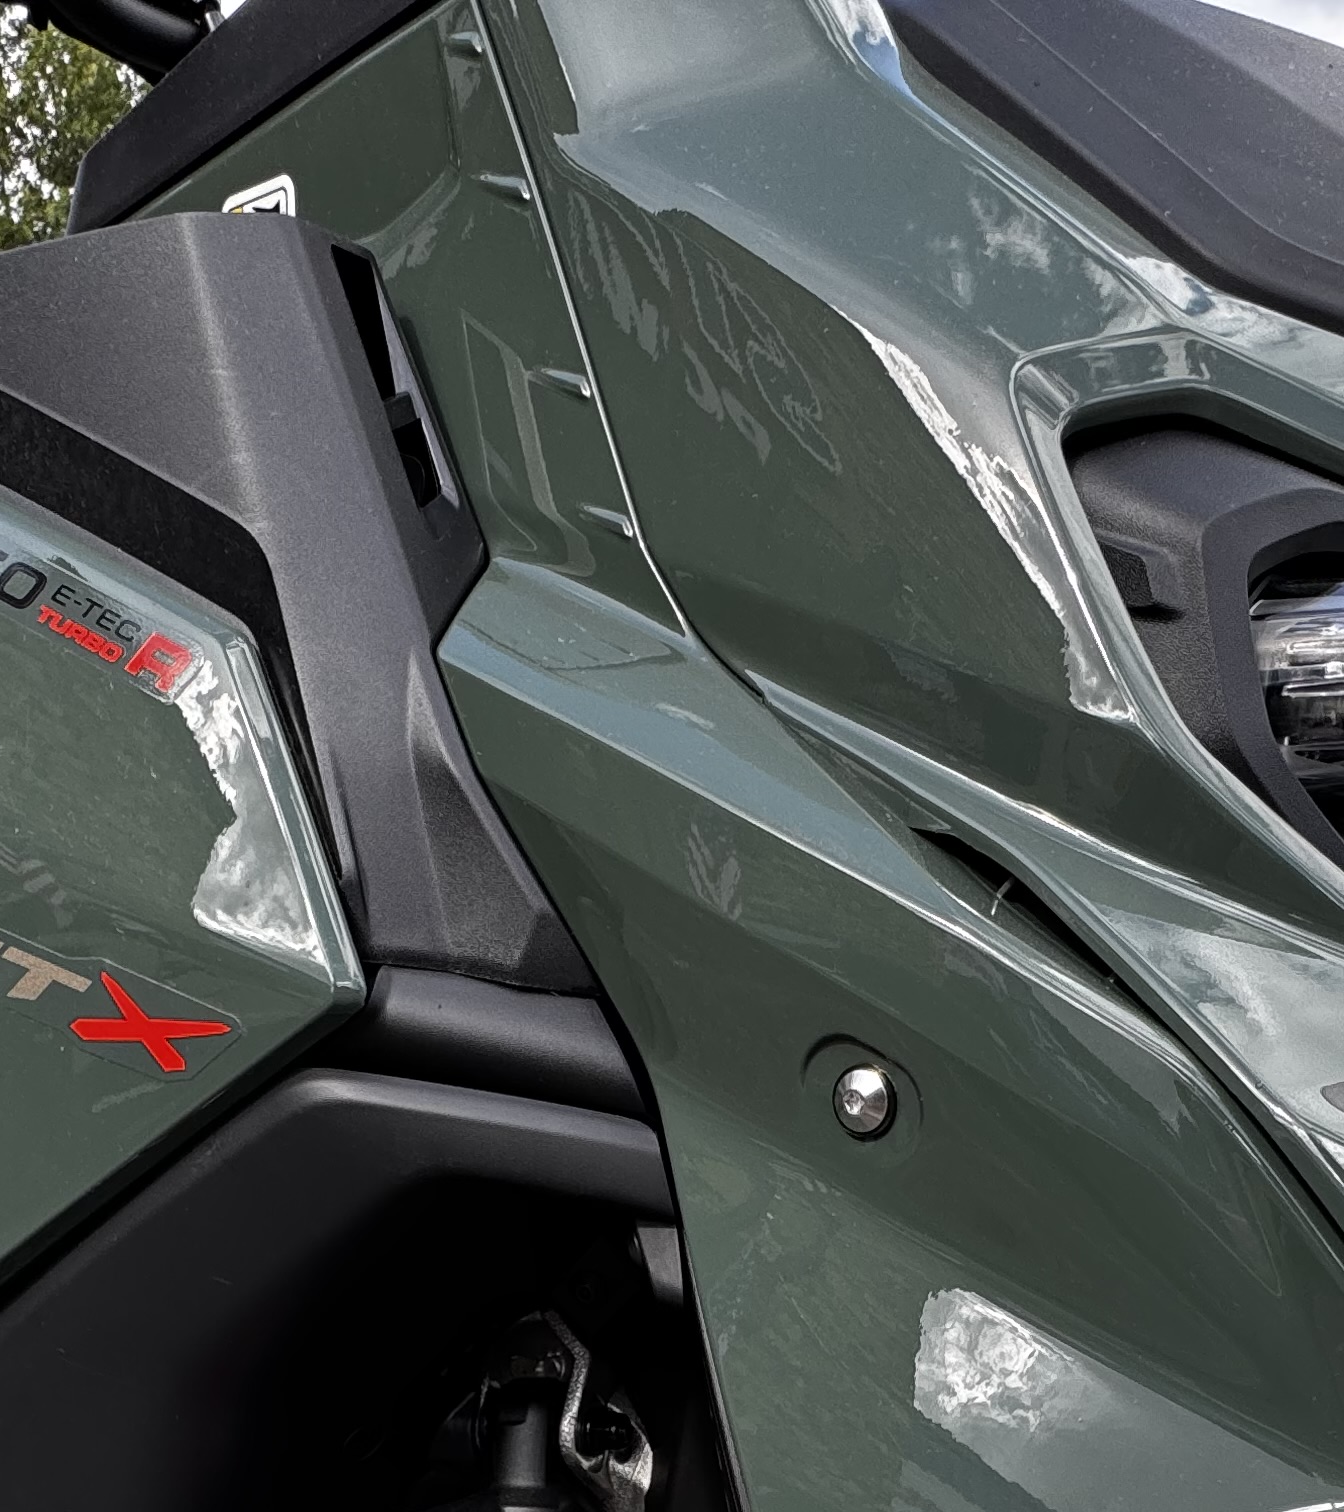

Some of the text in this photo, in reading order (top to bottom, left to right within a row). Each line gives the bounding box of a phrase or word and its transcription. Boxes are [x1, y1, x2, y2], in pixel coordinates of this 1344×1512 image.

[37, 604, 125, 663] TURBO
[50, 584, 142, 643] E-TEC
[69, 971, 232, 1072] X
